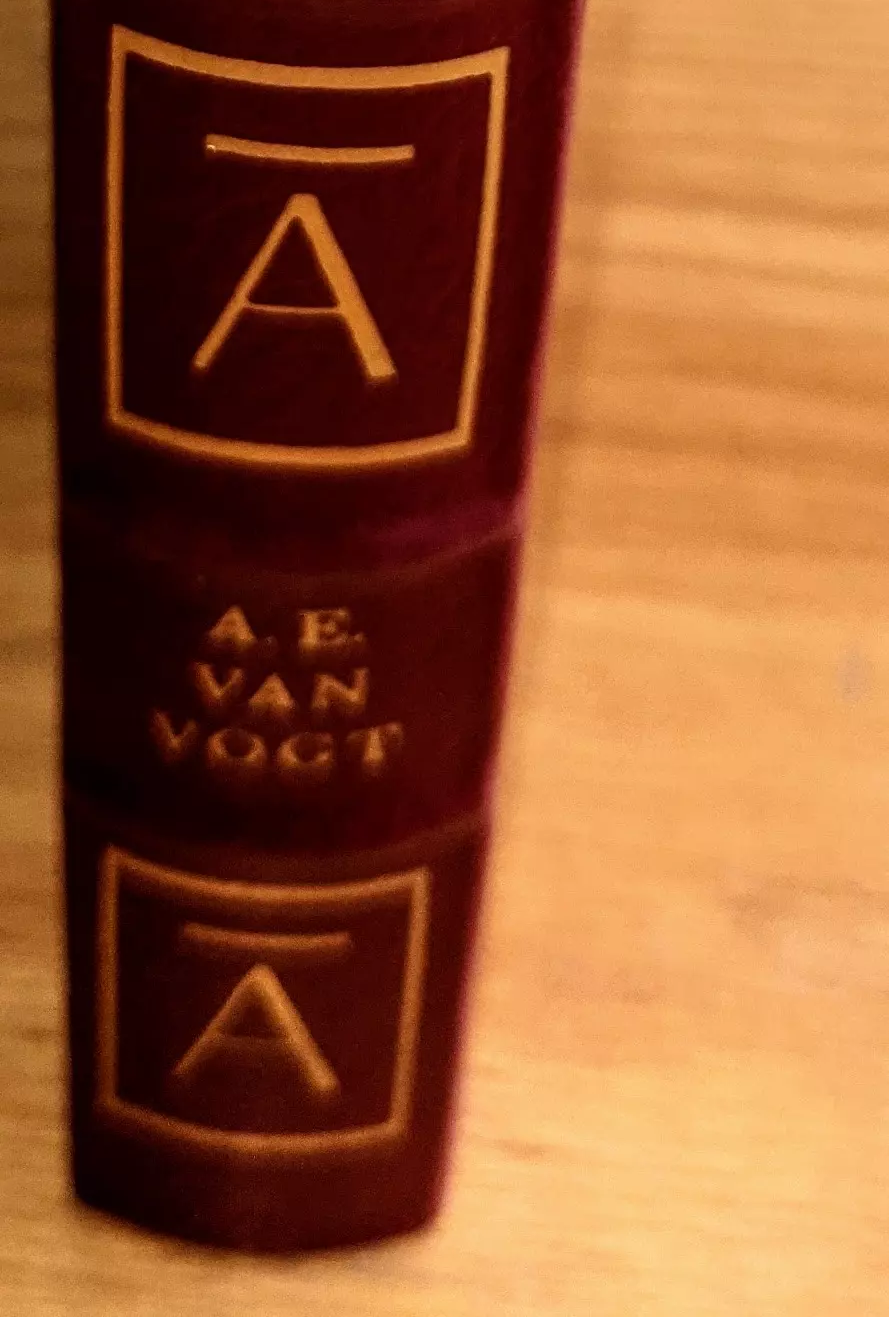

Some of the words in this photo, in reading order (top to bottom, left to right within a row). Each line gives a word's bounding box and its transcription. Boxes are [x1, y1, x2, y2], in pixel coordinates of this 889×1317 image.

[206, 604, 276, 651] A.
[298, 607, 365, 651] E.
[191, 661, 370, 717] VAN
[149, 707, 402, 772] VOGT
